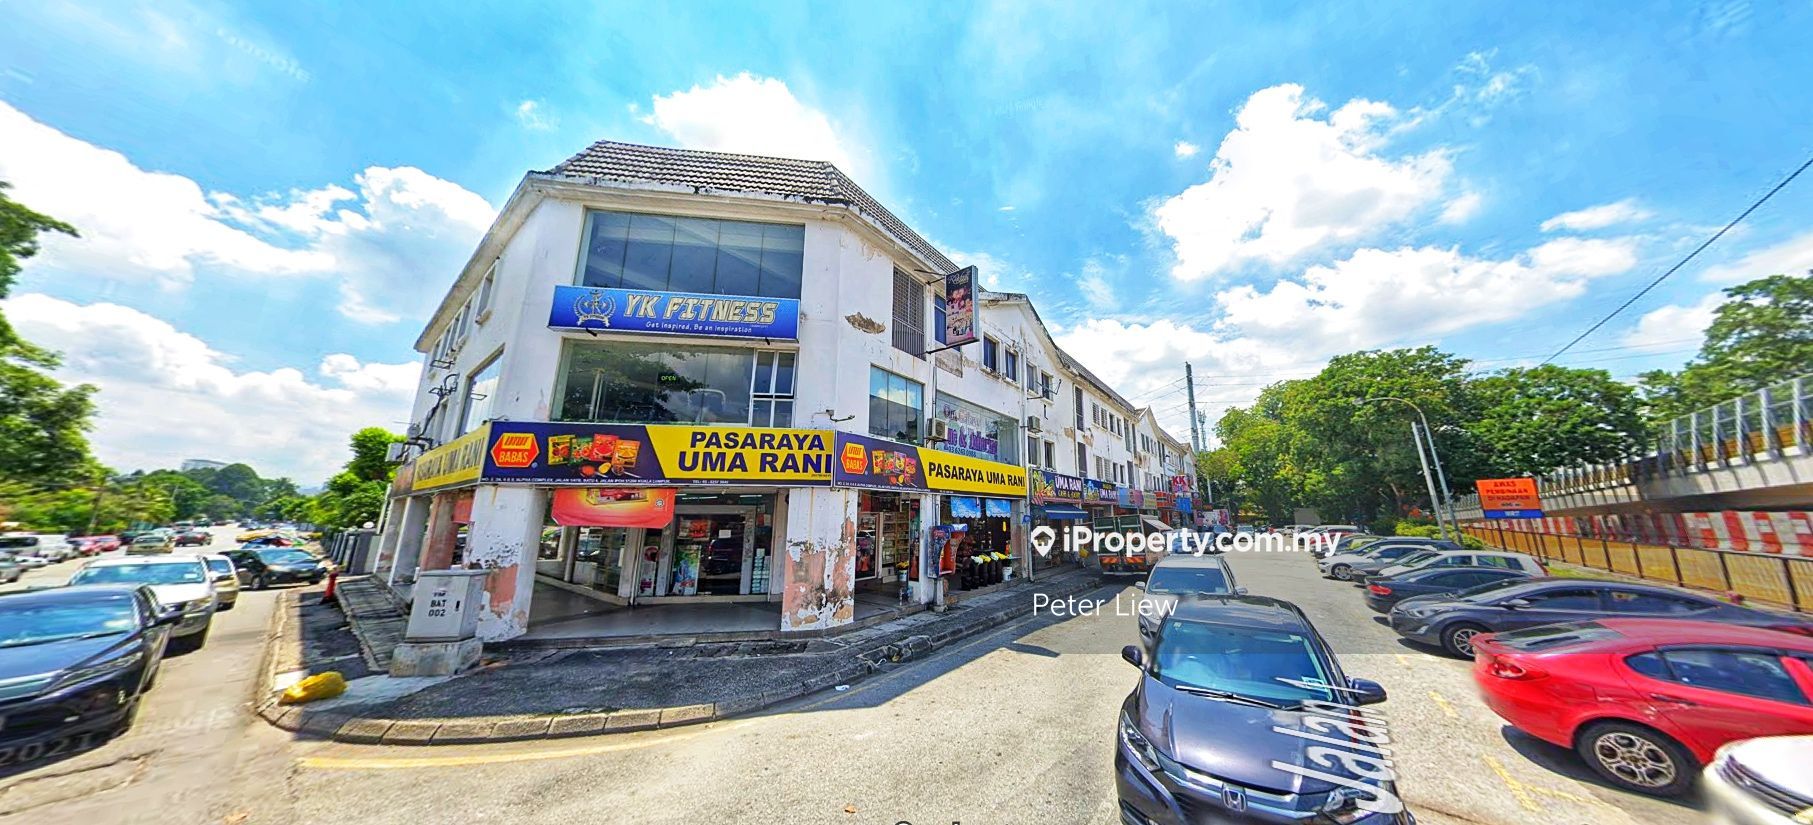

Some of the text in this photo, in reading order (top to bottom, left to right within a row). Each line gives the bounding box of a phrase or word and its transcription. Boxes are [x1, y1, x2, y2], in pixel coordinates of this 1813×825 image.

[624, 294, 778, 324] YK FITNESS
[690, 431, 825, 451] PASARAYA
[678, 451, 831, 473] UMA RANI
[928, 461, 1025, 487] PASARAYA UMA RANI
[1172, 475, 1186, 485] KK
[428, 609, 446, 617] 002
